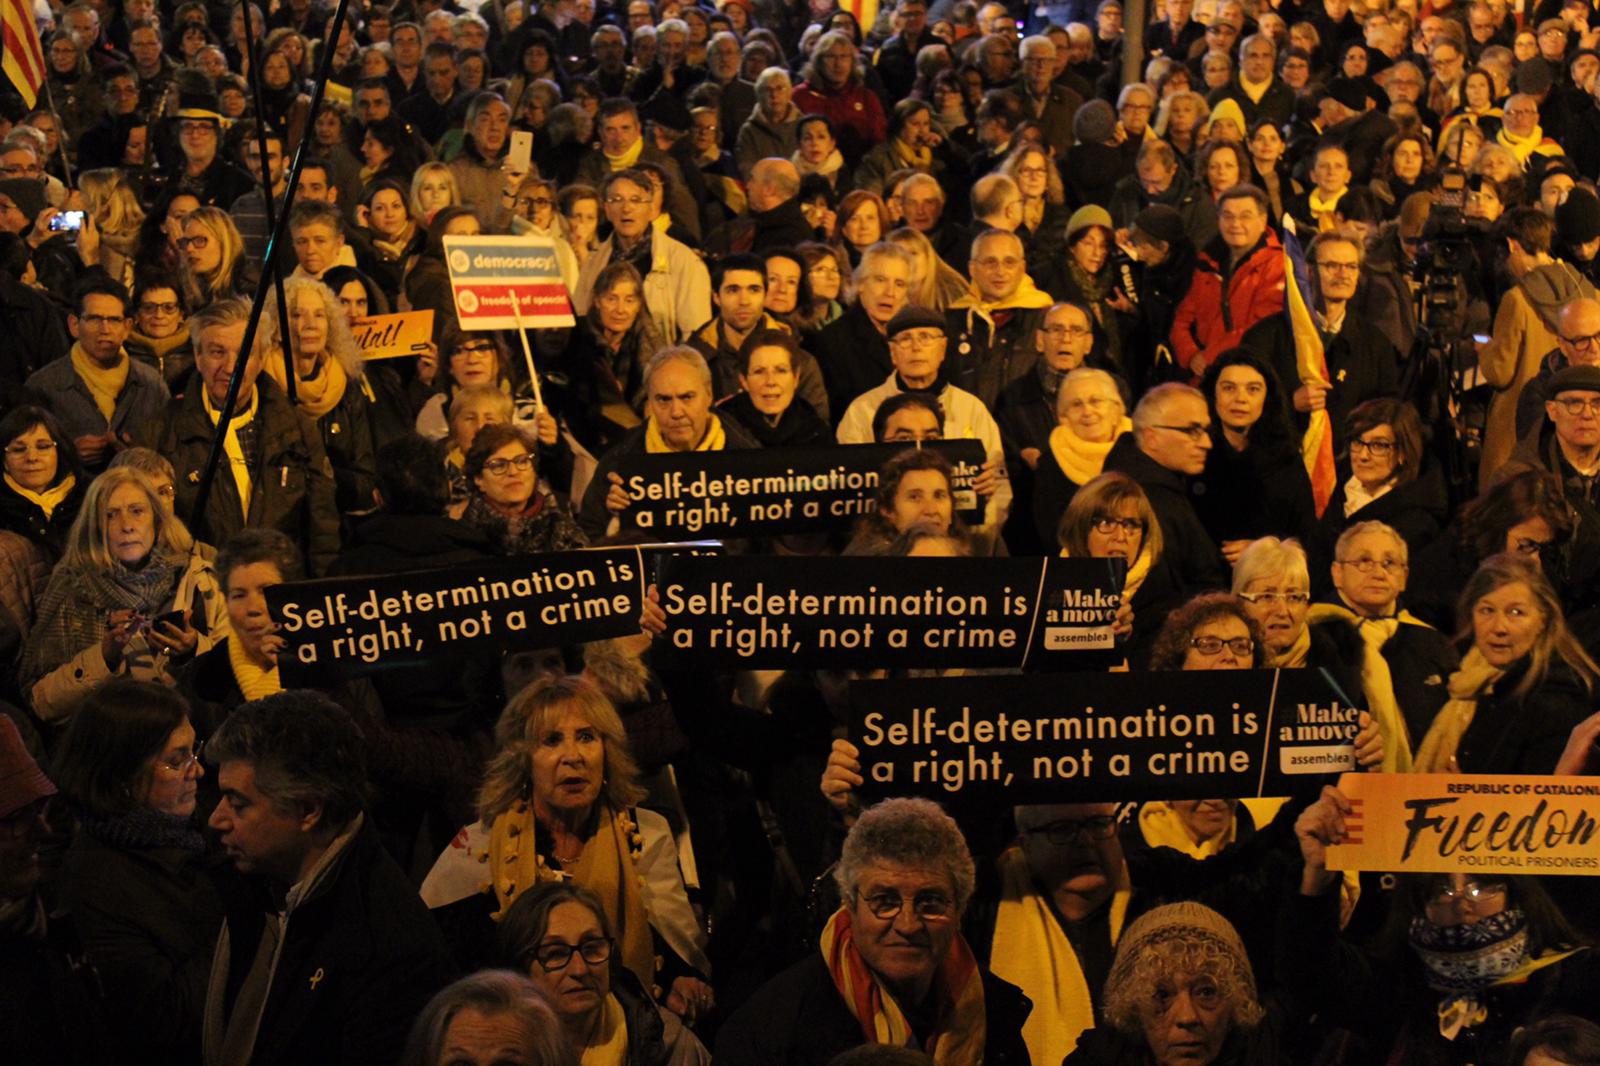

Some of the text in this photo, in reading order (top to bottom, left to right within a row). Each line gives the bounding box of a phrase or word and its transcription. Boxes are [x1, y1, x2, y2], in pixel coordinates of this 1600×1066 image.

[629, 466, 880, 500] Self-determination
[635, 510, 655, 528] a
[665, 498, 738, 532] right,
[750, 501, 793, 521] not
[803, 502, 820, 518] a
[281, 559, 635, 632] Self-determination is
[664, 582, 1028, 616] Self-determination is
[1063, 587, 1120, 608] Make
[298, 593, 631, 664] a right, not a crime
[1046, 608, 1060, 623] a
[673, 617, 1017, 657] a right, not a crime
[1054, 632, 1108, 642] assemblea
[863, 702, 1259, 746] Self-determination is
[1296, 702, 1358, 724] Make
[1279, 724, 1358, 742] a move
[871, 741, 1250, 792] a right, not a crime
[1290, 752, 1349, 765] assemblea
[1447, 783, 1600, 796] REPUBLIC OF CATALONI
[1458, 855, 1598, 868] POLITICAL PRISONERS
